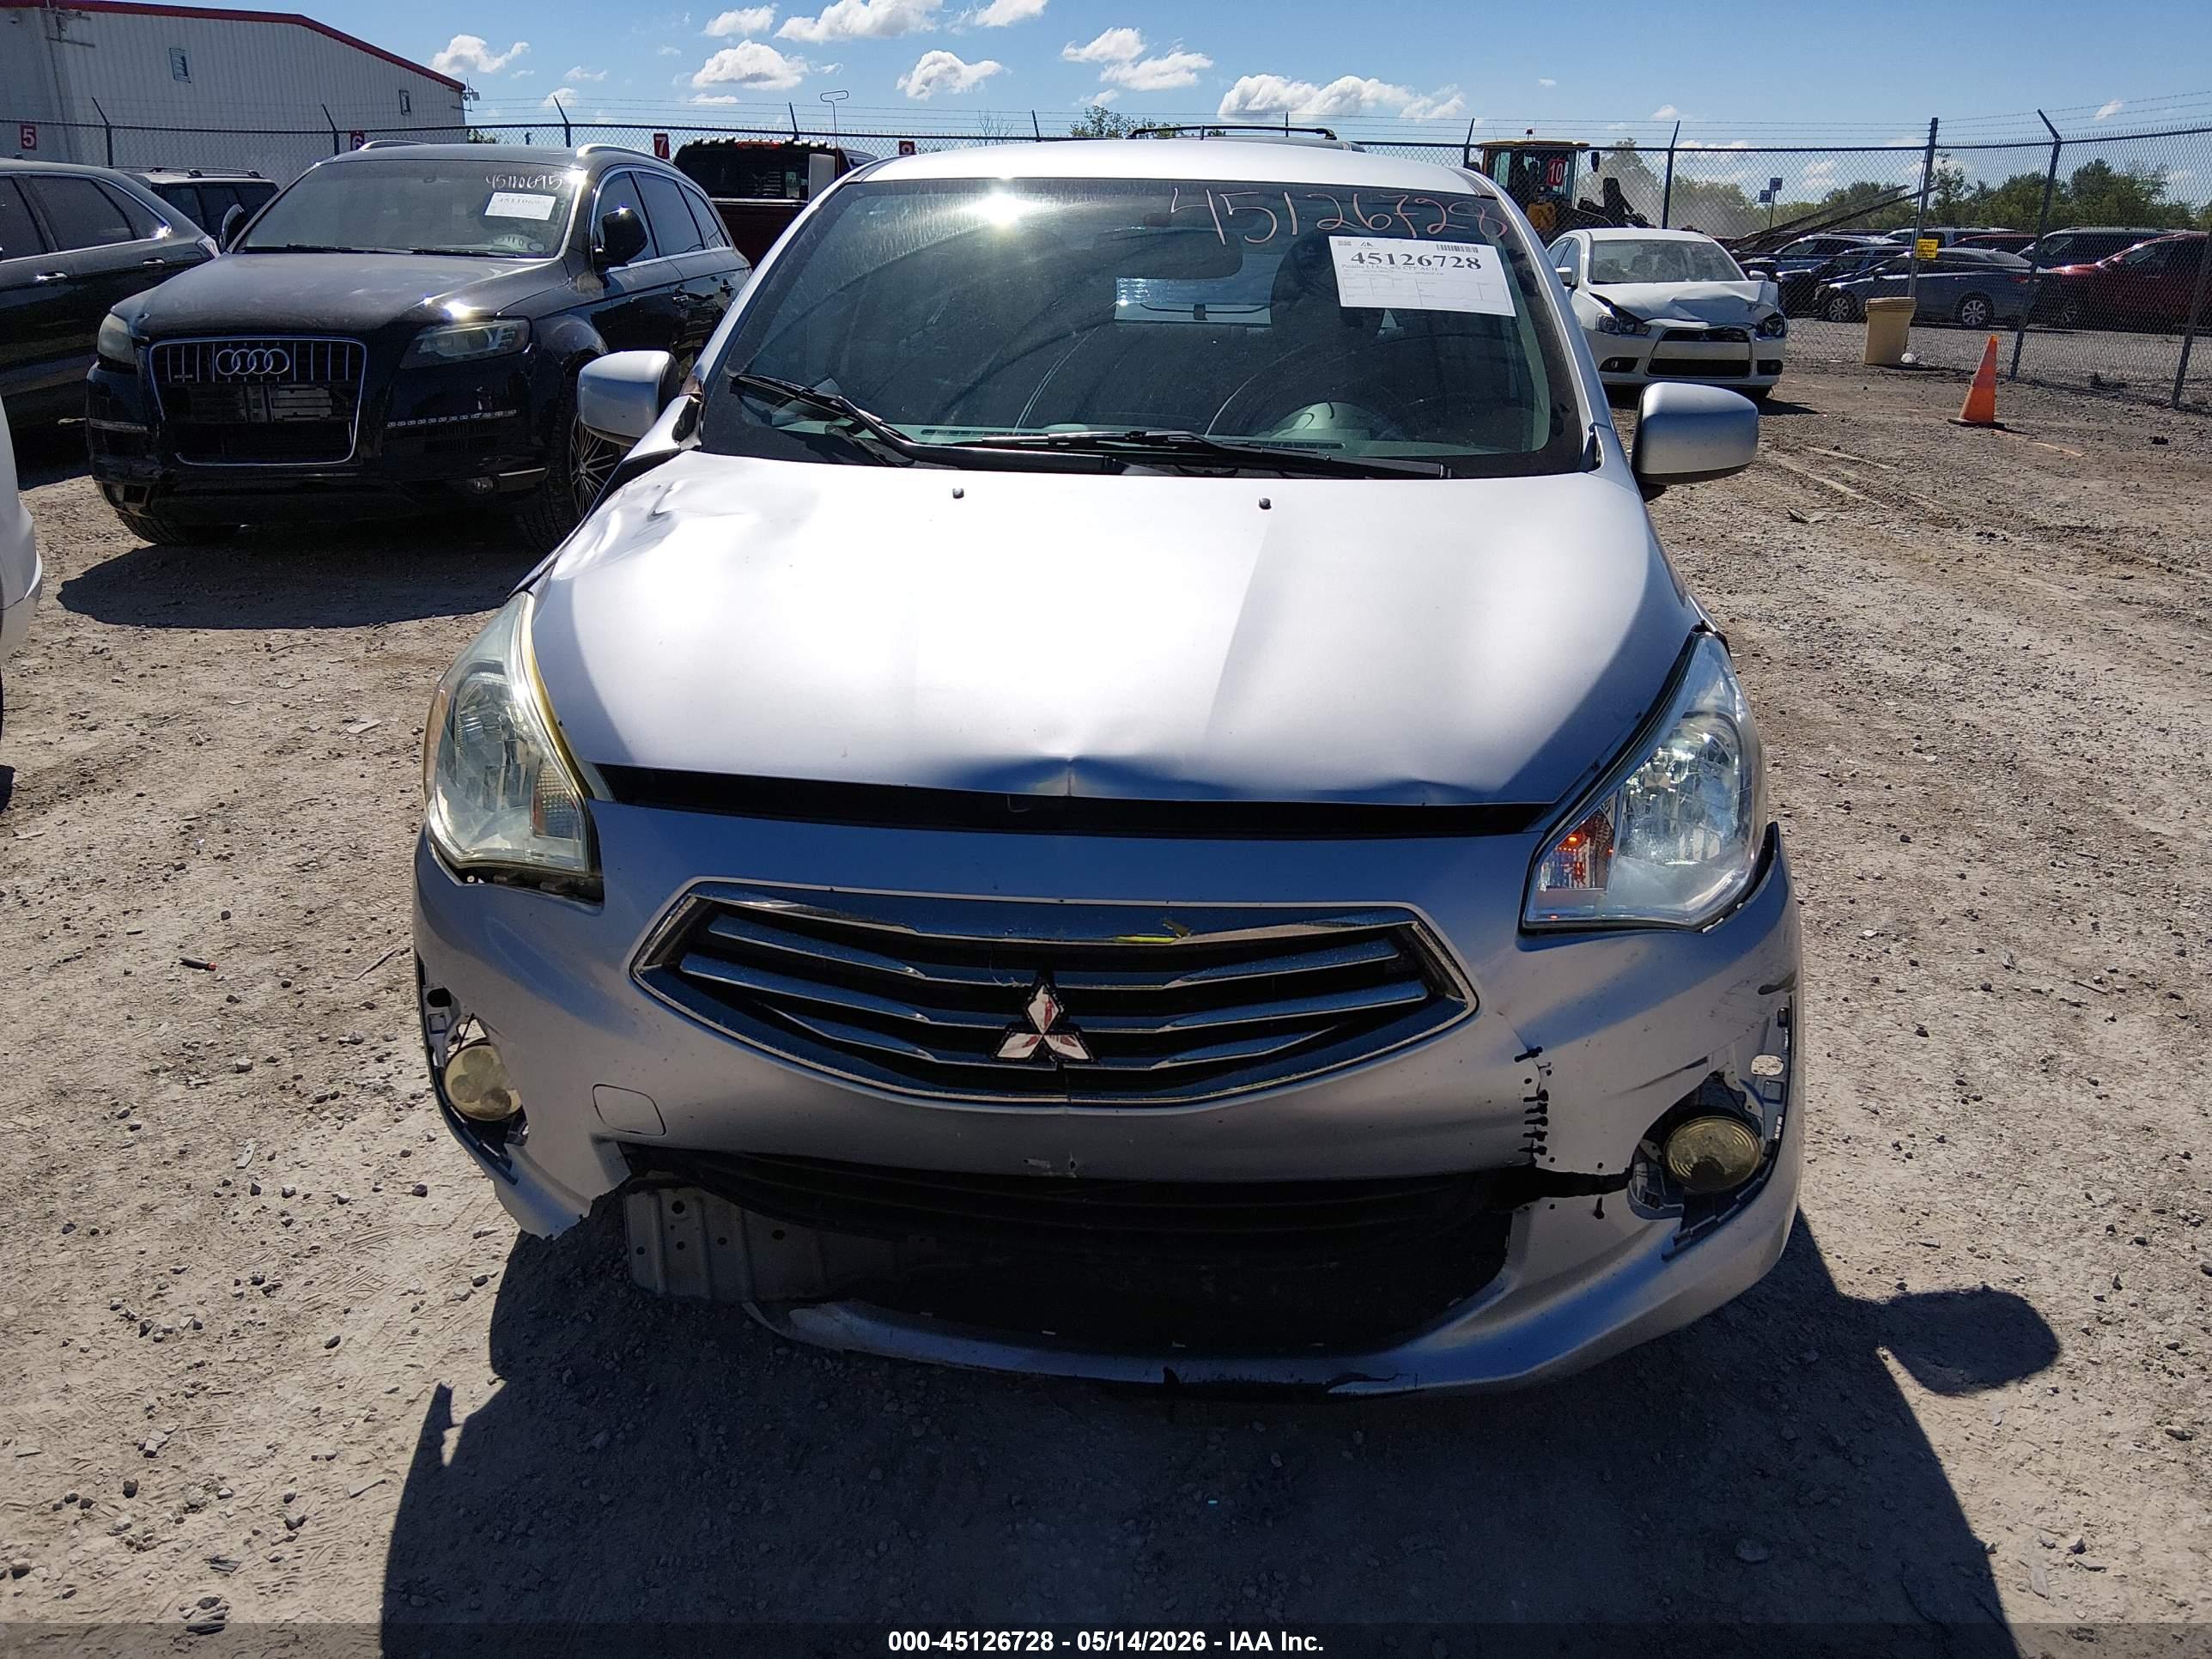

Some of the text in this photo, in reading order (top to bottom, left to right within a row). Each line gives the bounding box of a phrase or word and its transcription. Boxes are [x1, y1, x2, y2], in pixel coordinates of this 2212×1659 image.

[23, 128, 35, 147] 5
[655, 137, 667, 156] 7
[1550, 161, 1563, 183] 10
[485, 173, 562, 191] 45110695
[1170, 187, 1508, 246] 45126728
[1351, 252, 1482, 270] 45126728
